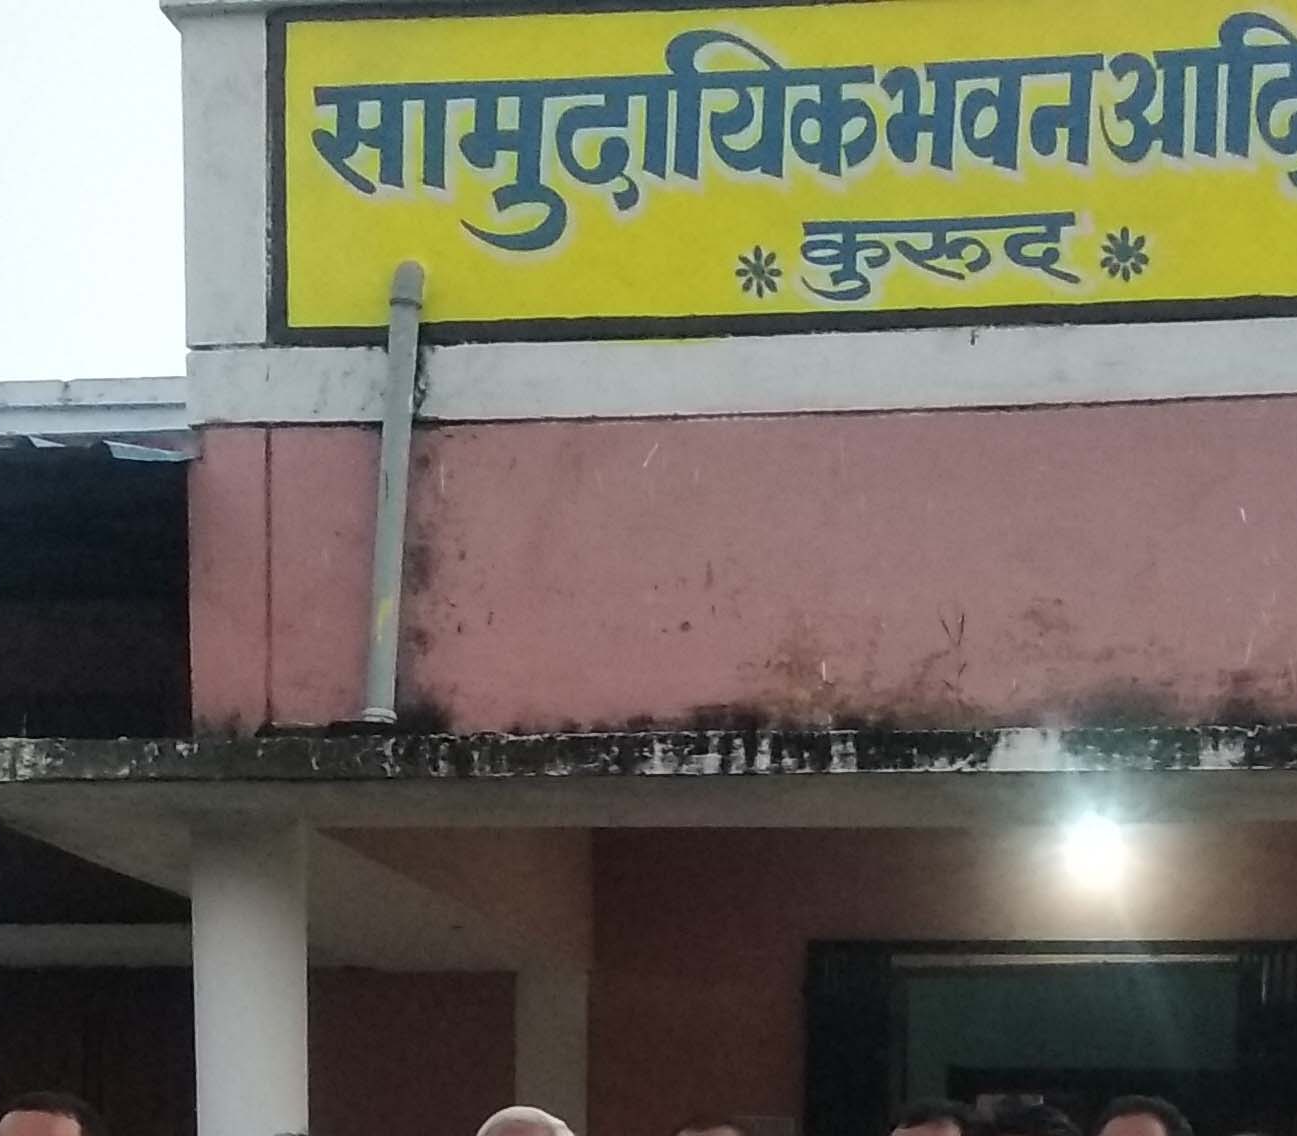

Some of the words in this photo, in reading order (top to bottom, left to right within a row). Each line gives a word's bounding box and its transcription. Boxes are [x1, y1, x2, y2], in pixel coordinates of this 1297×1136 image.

[312, 30, 877, 251] सामुदायिक
[881, 53, 1103, 170] भवन
[801, 212, 1081, 300] कुरूद
